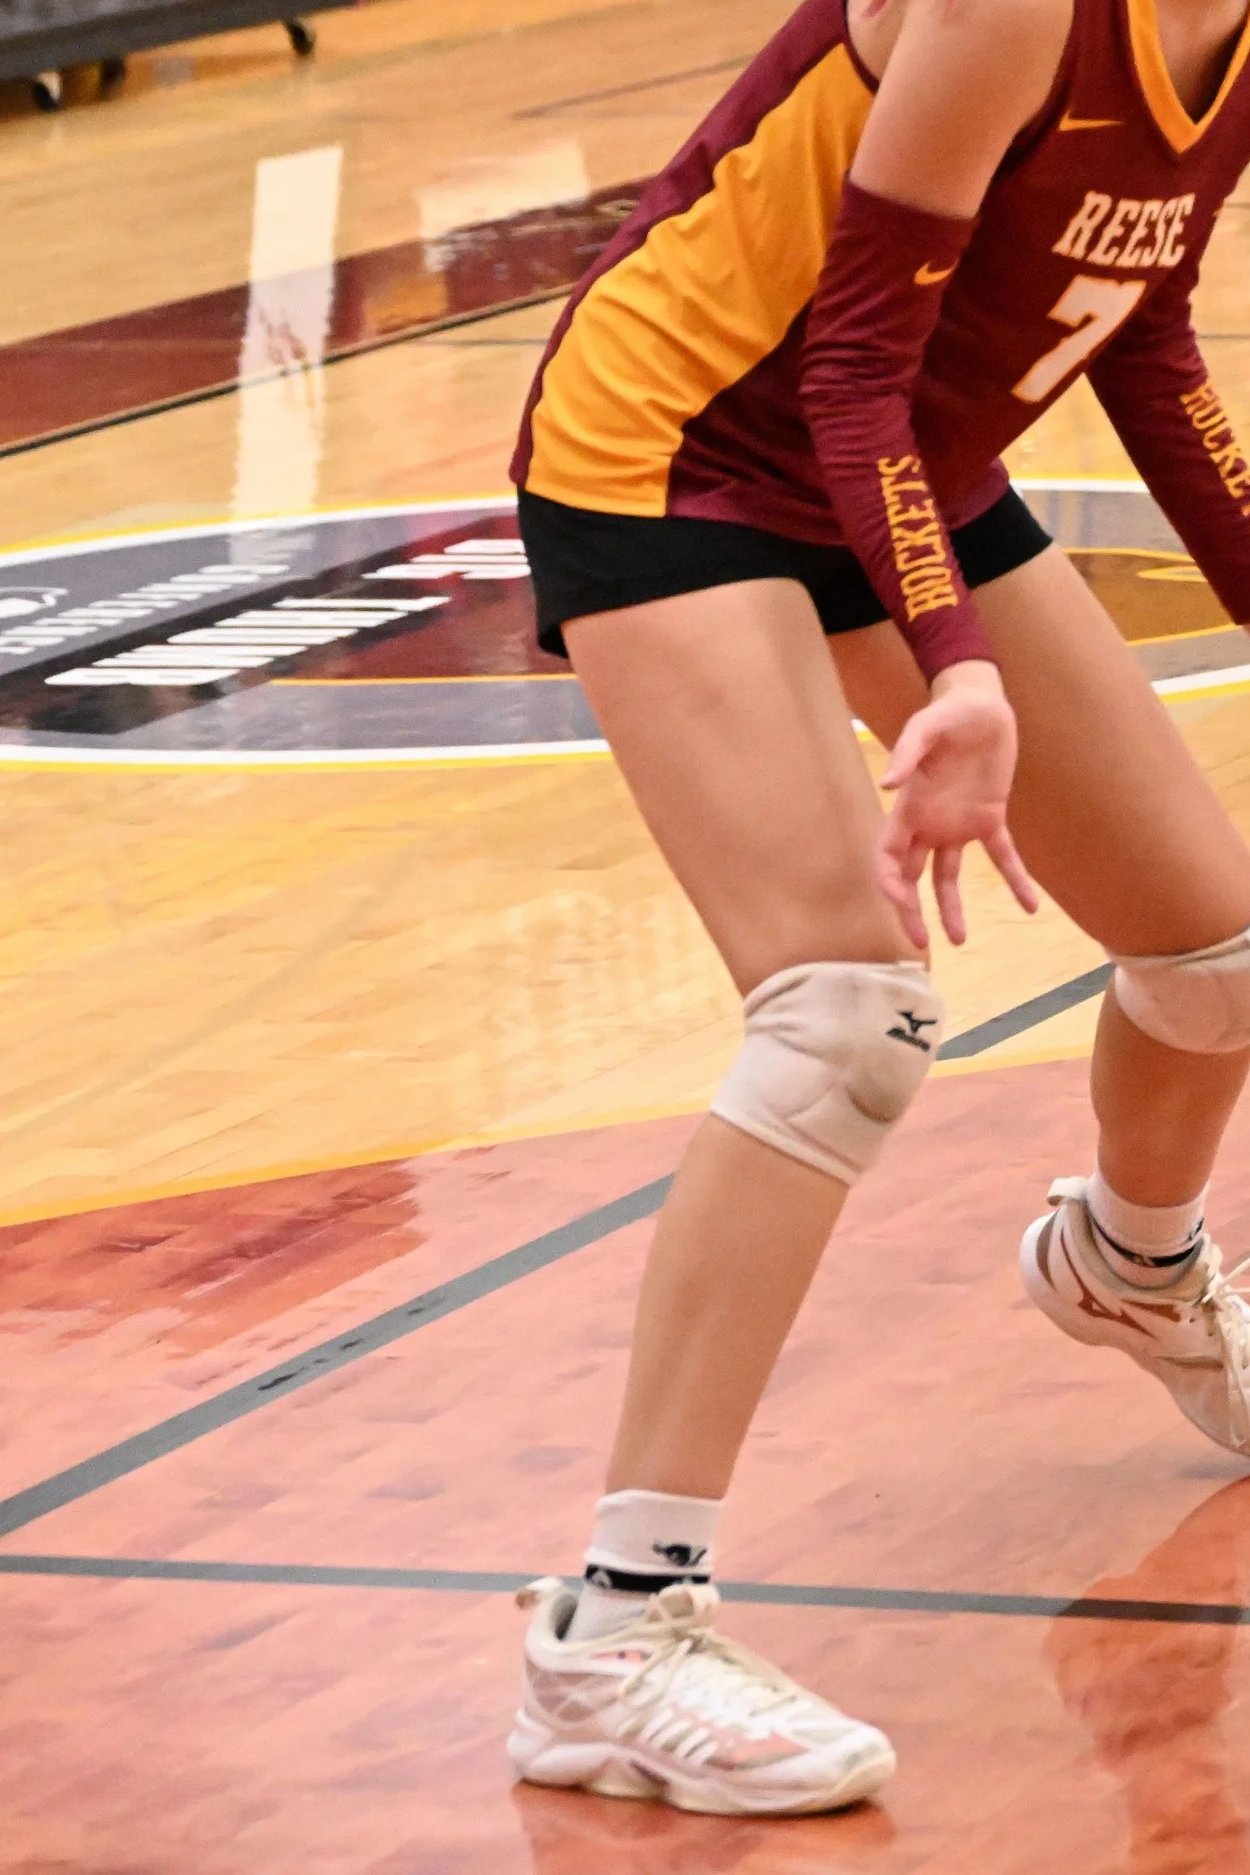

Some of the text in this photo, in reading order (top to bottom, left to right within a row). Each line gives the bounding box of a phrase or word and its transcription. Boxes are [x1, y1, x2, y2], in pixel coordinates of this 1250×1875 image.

[1052, 191, 1196, 269] REESE
[1010, 277, 1147, 405] 7
[877, 454, 959, 623] ROCKETS
[44, 596, 452, 686] THUMB
